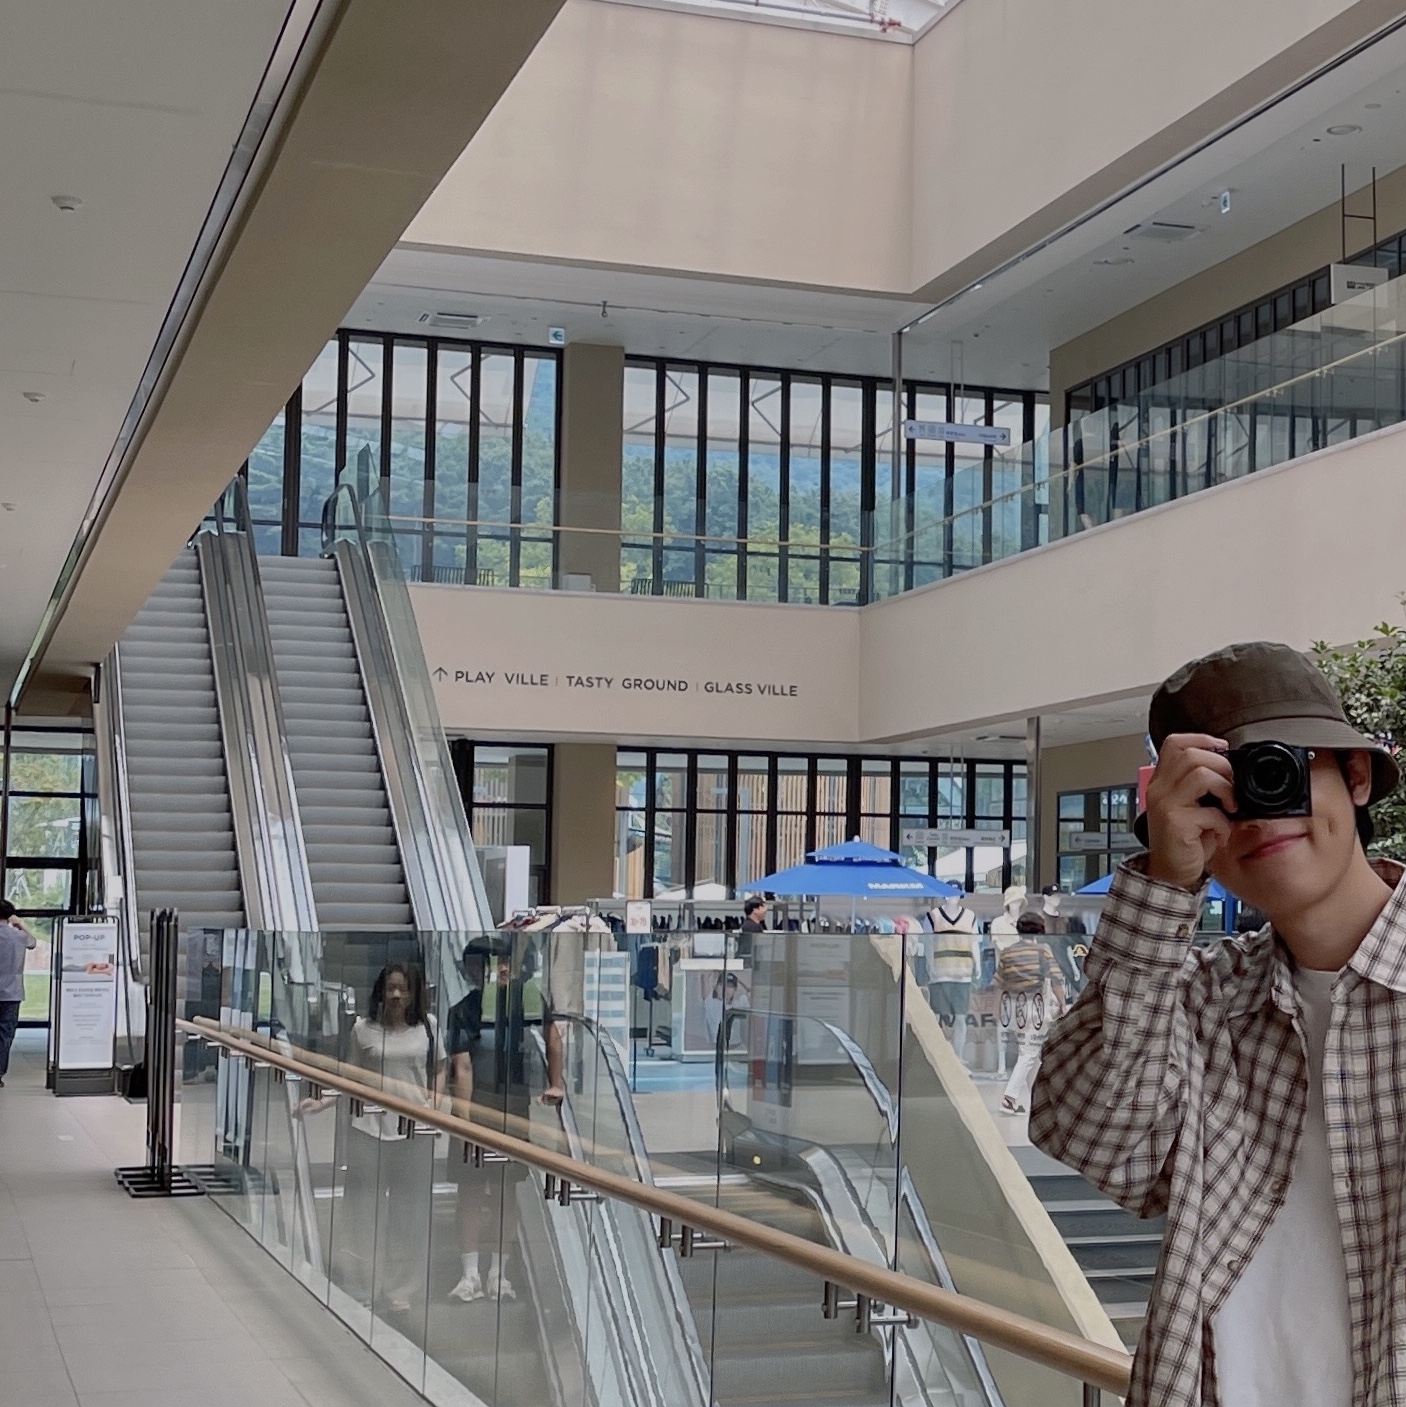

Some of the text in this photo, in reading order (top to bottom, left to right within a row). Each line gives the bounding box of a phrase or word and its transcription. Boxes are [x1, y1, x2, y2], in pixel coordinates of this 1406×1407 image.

[455, 670, 798, 697] PLAY VILLE TASTY GROUND GLASS VILLE
